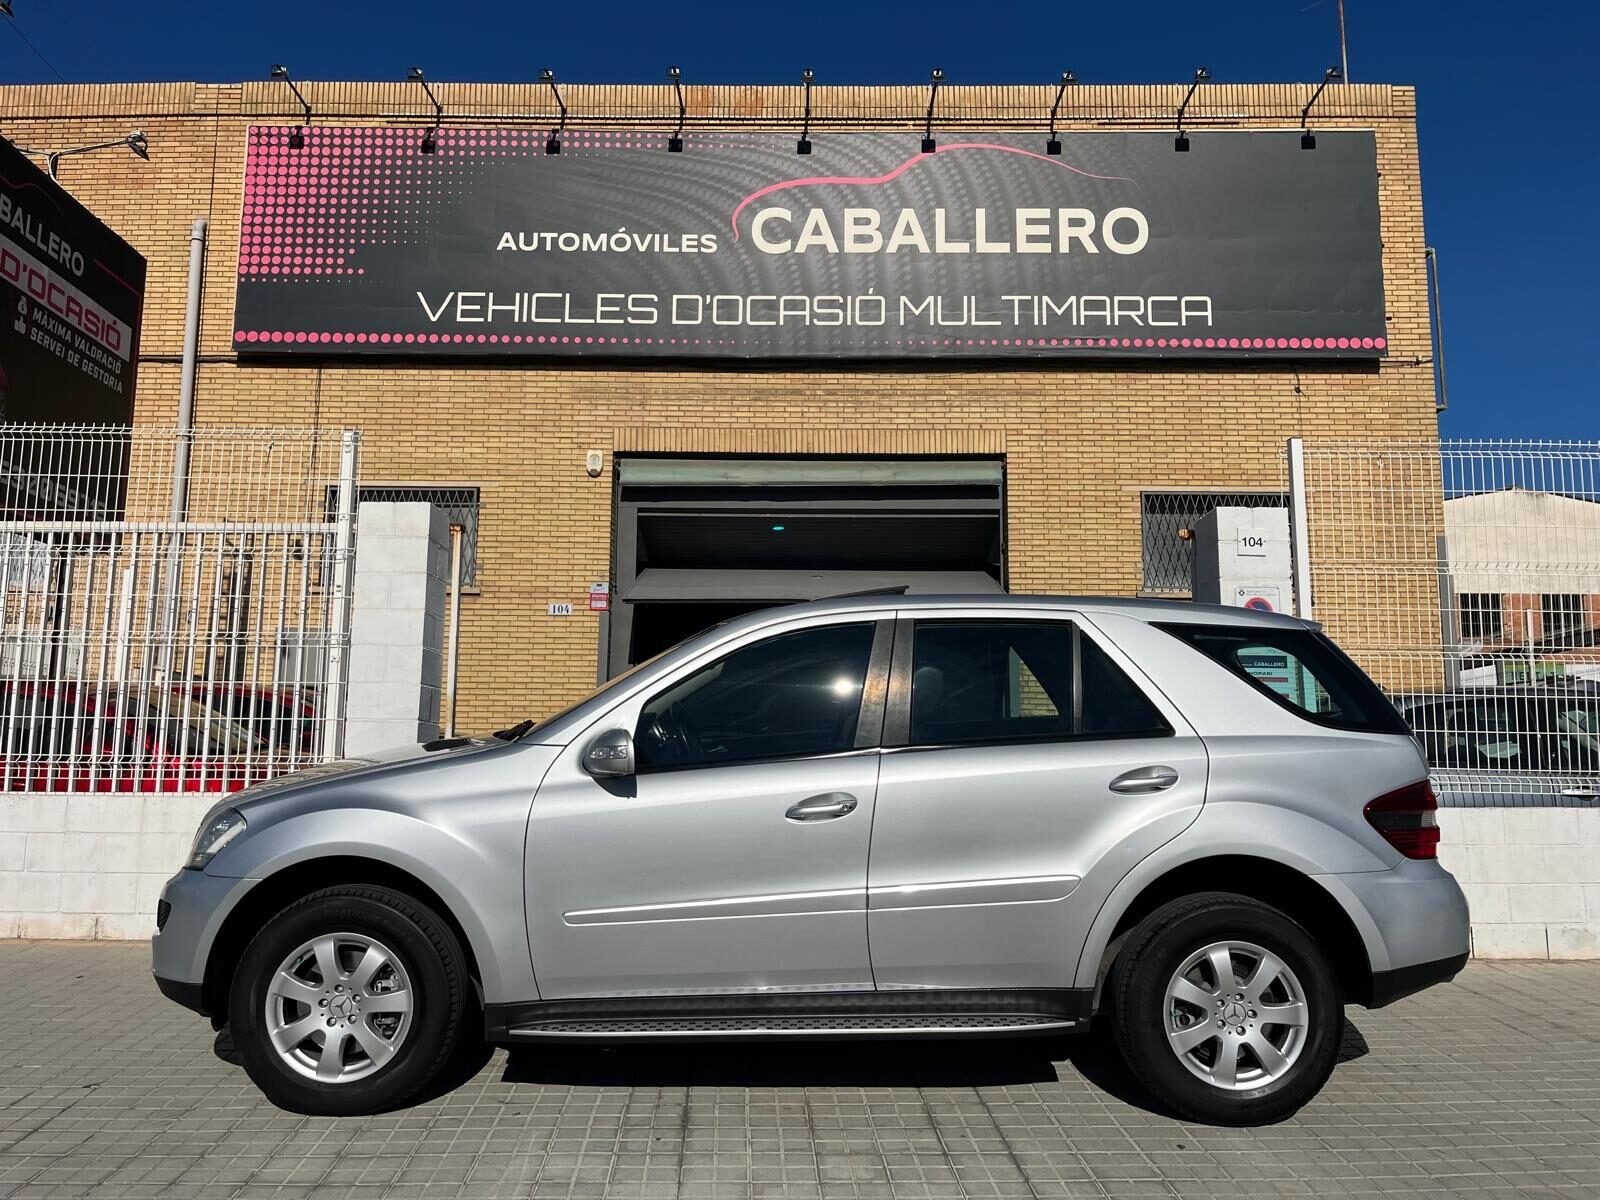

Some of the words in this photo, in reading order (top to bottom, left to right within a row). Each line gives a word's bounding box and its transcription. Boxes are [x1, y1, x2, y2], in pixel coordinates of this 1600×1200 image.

[0, 193, 85, 277] BALLERO
[496, 226, 718, 254] AUTOMÓVILES
[751, 207, 1149, 255] CABALLERO
[0, 247, 122, 352] D'OCASIÓ
[416, 291, 659, 325] VEHICLES
[671, 287, 886, 327] D'OCASIÓ
[899, 295, 1213, 327] MULTIMARCA
[30, 328, 66, 358] SERVEI
[68, 350, 80, 367] DE
[82, 360, 122, 394] GESTORIA
[74, 334, 122, 374] VALORACIÓ
[1241, 536, 1263, 547] 104
[553, 605, 569, 613] 104
